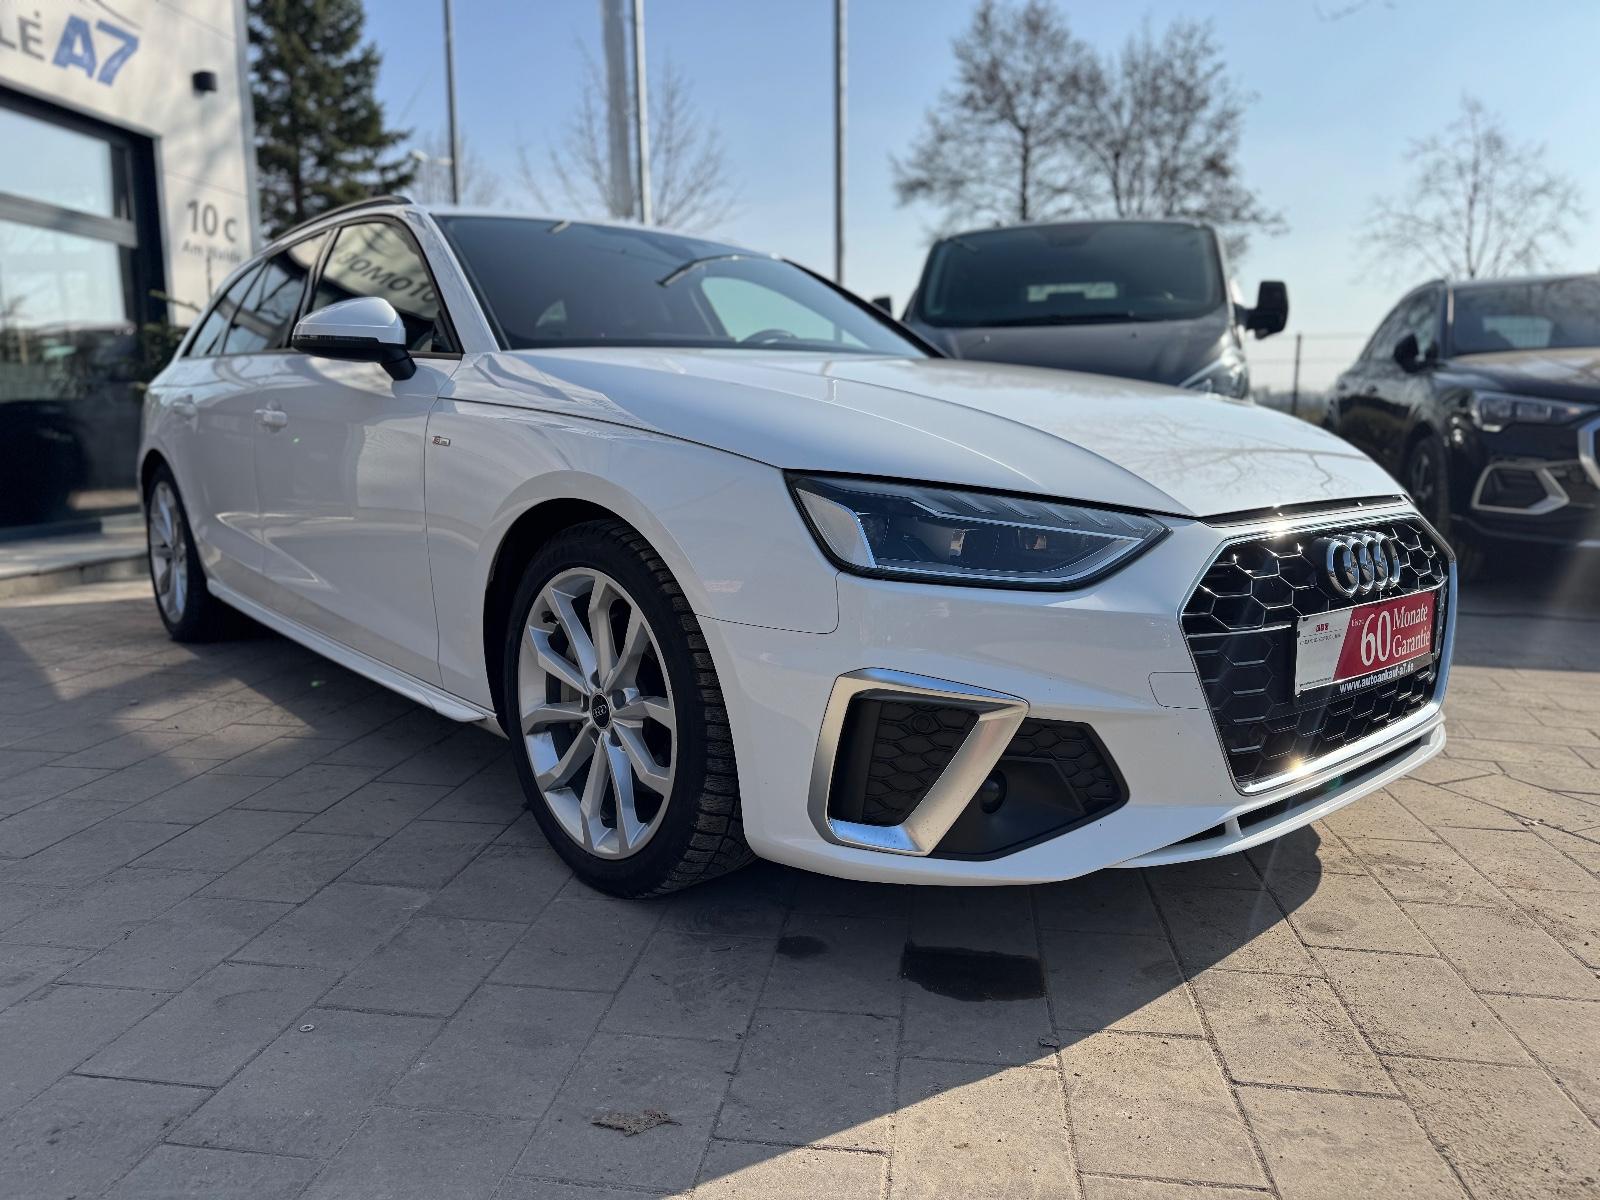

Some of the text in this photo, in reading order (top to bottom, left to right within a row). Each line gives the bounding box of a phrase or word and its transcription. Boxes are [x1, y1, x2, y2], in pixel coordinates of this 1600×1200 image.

[52, 14, 139, 87] A7
[187, 199, 218, 237] 10
[1393, 603, 1428, 631] Monate
[1360, 610, 1391, 666] 60
[1339, 662, 1414, 694] www.autoankauf-a7.de
